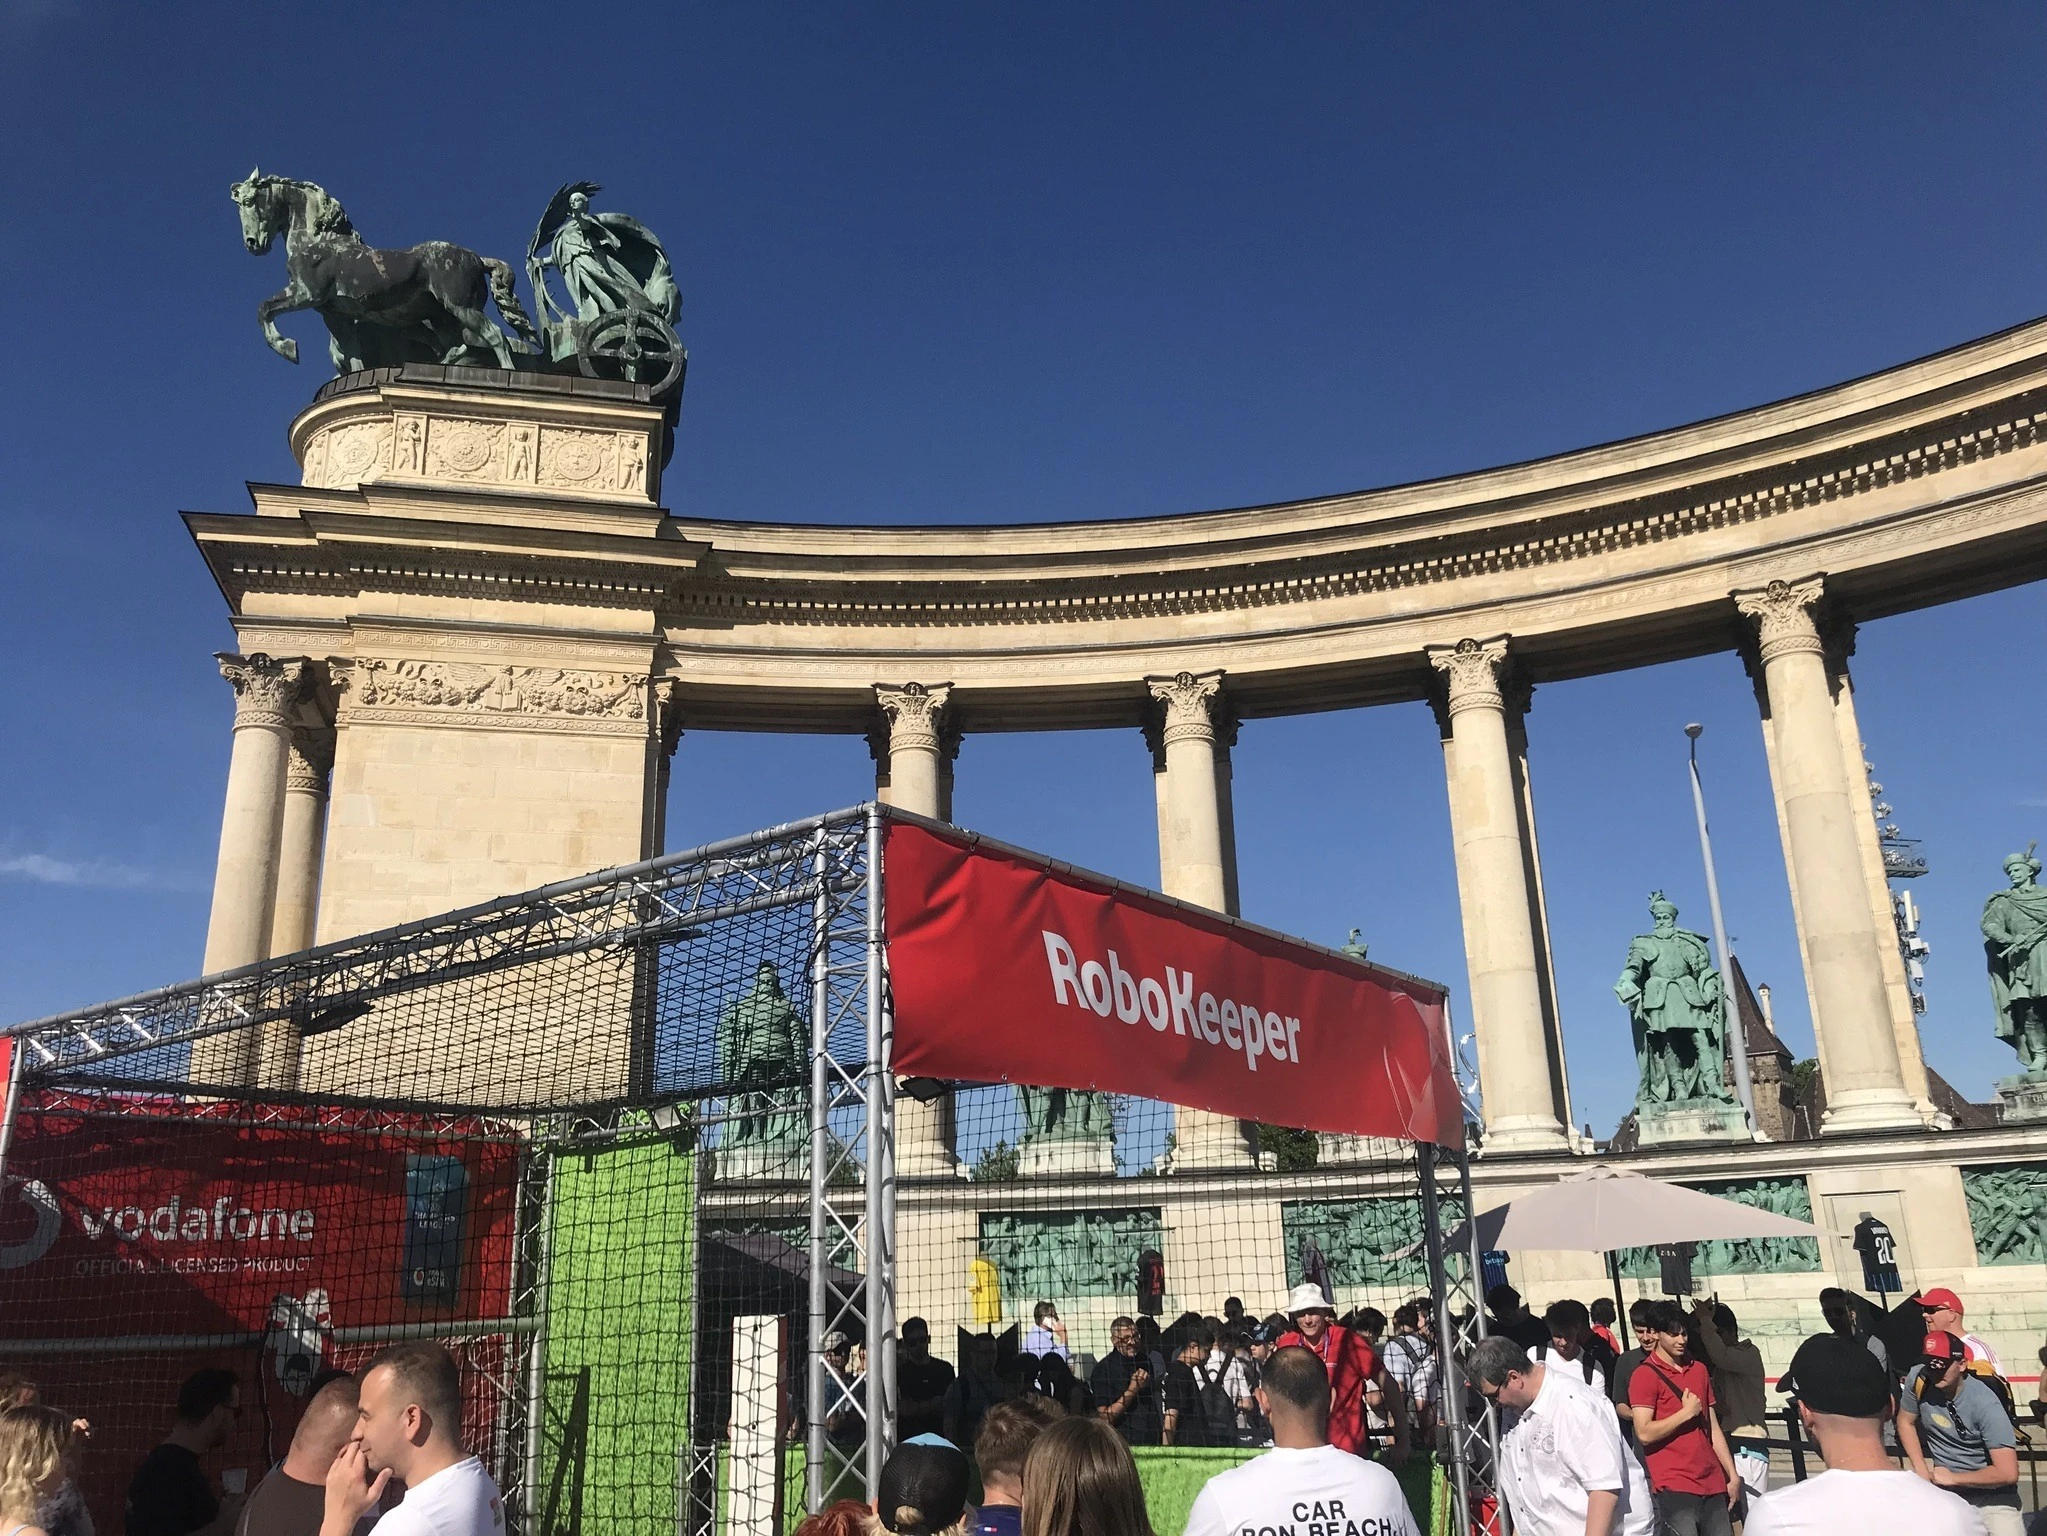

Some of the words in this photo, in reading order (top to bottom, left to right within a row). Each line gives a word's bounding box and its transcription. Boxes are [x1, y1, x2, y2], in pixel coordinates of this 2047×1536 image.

[1041, 930, 1300, 1072] RoboKeeper
[79, 1194, 315, 1242] vodafone
[1875, 1236, 1896, 1264] 20
[75, 1258, 156, 1275] OFFICIAL
[159, 1256, 238, 1274] LICENSED
[242, 1255, 315, 1273] PRODUCT
[1292, 1500, 1346, 1522] CAR
